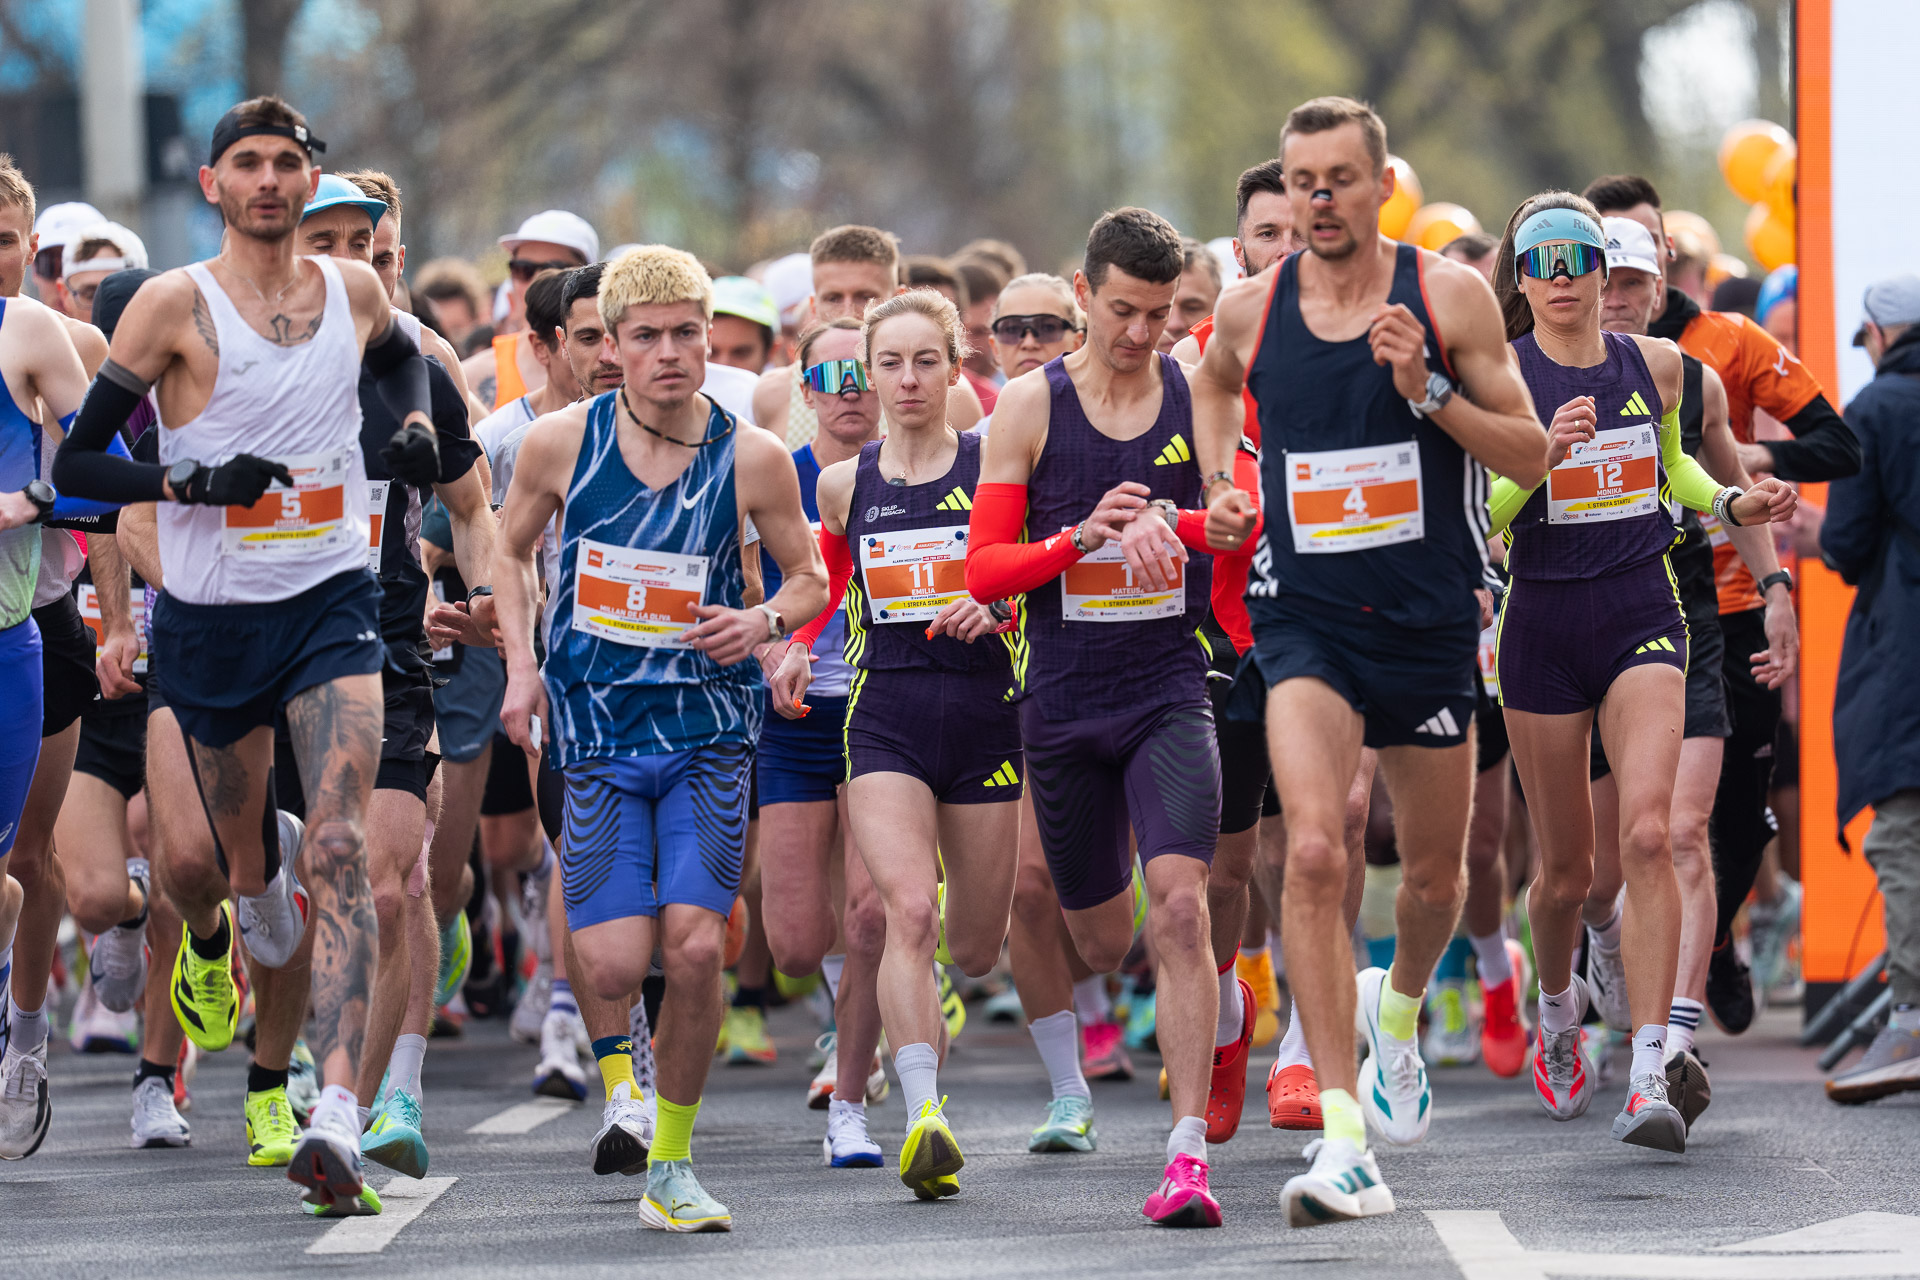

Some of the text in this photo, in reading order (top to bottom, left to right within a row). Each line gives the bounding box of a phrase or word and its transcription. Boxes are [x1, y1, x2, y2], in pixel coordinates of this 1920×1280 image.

[1593, 462, 1624, 489] 12
[1596, 487, 1622, 497] MONIKA
[281, 491, 302, 519] 5
[1342, 486, 1368, 513] 4
[1592, 500, 1613, 509] STREFA
[1613, 498, 1631, 506] STARTU
[880, 508, 906, 518] BIEGACZA
[881, 504, 898, 512] SKLEP
[908, 562, 935, 588] 11
[1121, 562, 1133, 587] 1
[626, 584, 647, 611] 8
[911, 587, 936, 597] EMILIA
[907, 600, 927, 608] STREFA
[1108, 600, 1130, 608] STREFA
[1131, 599, 1154, 607] STARTU
[600, 604, 626, 617] MILLAN
[627, 610, 638, 618] DE
[639, 611, 649, 619] LA
[649, 612, 671, 622] OLIVA
[613, 621, 635, 630] STREFA
[636, 624, 659, 633] STARTU
